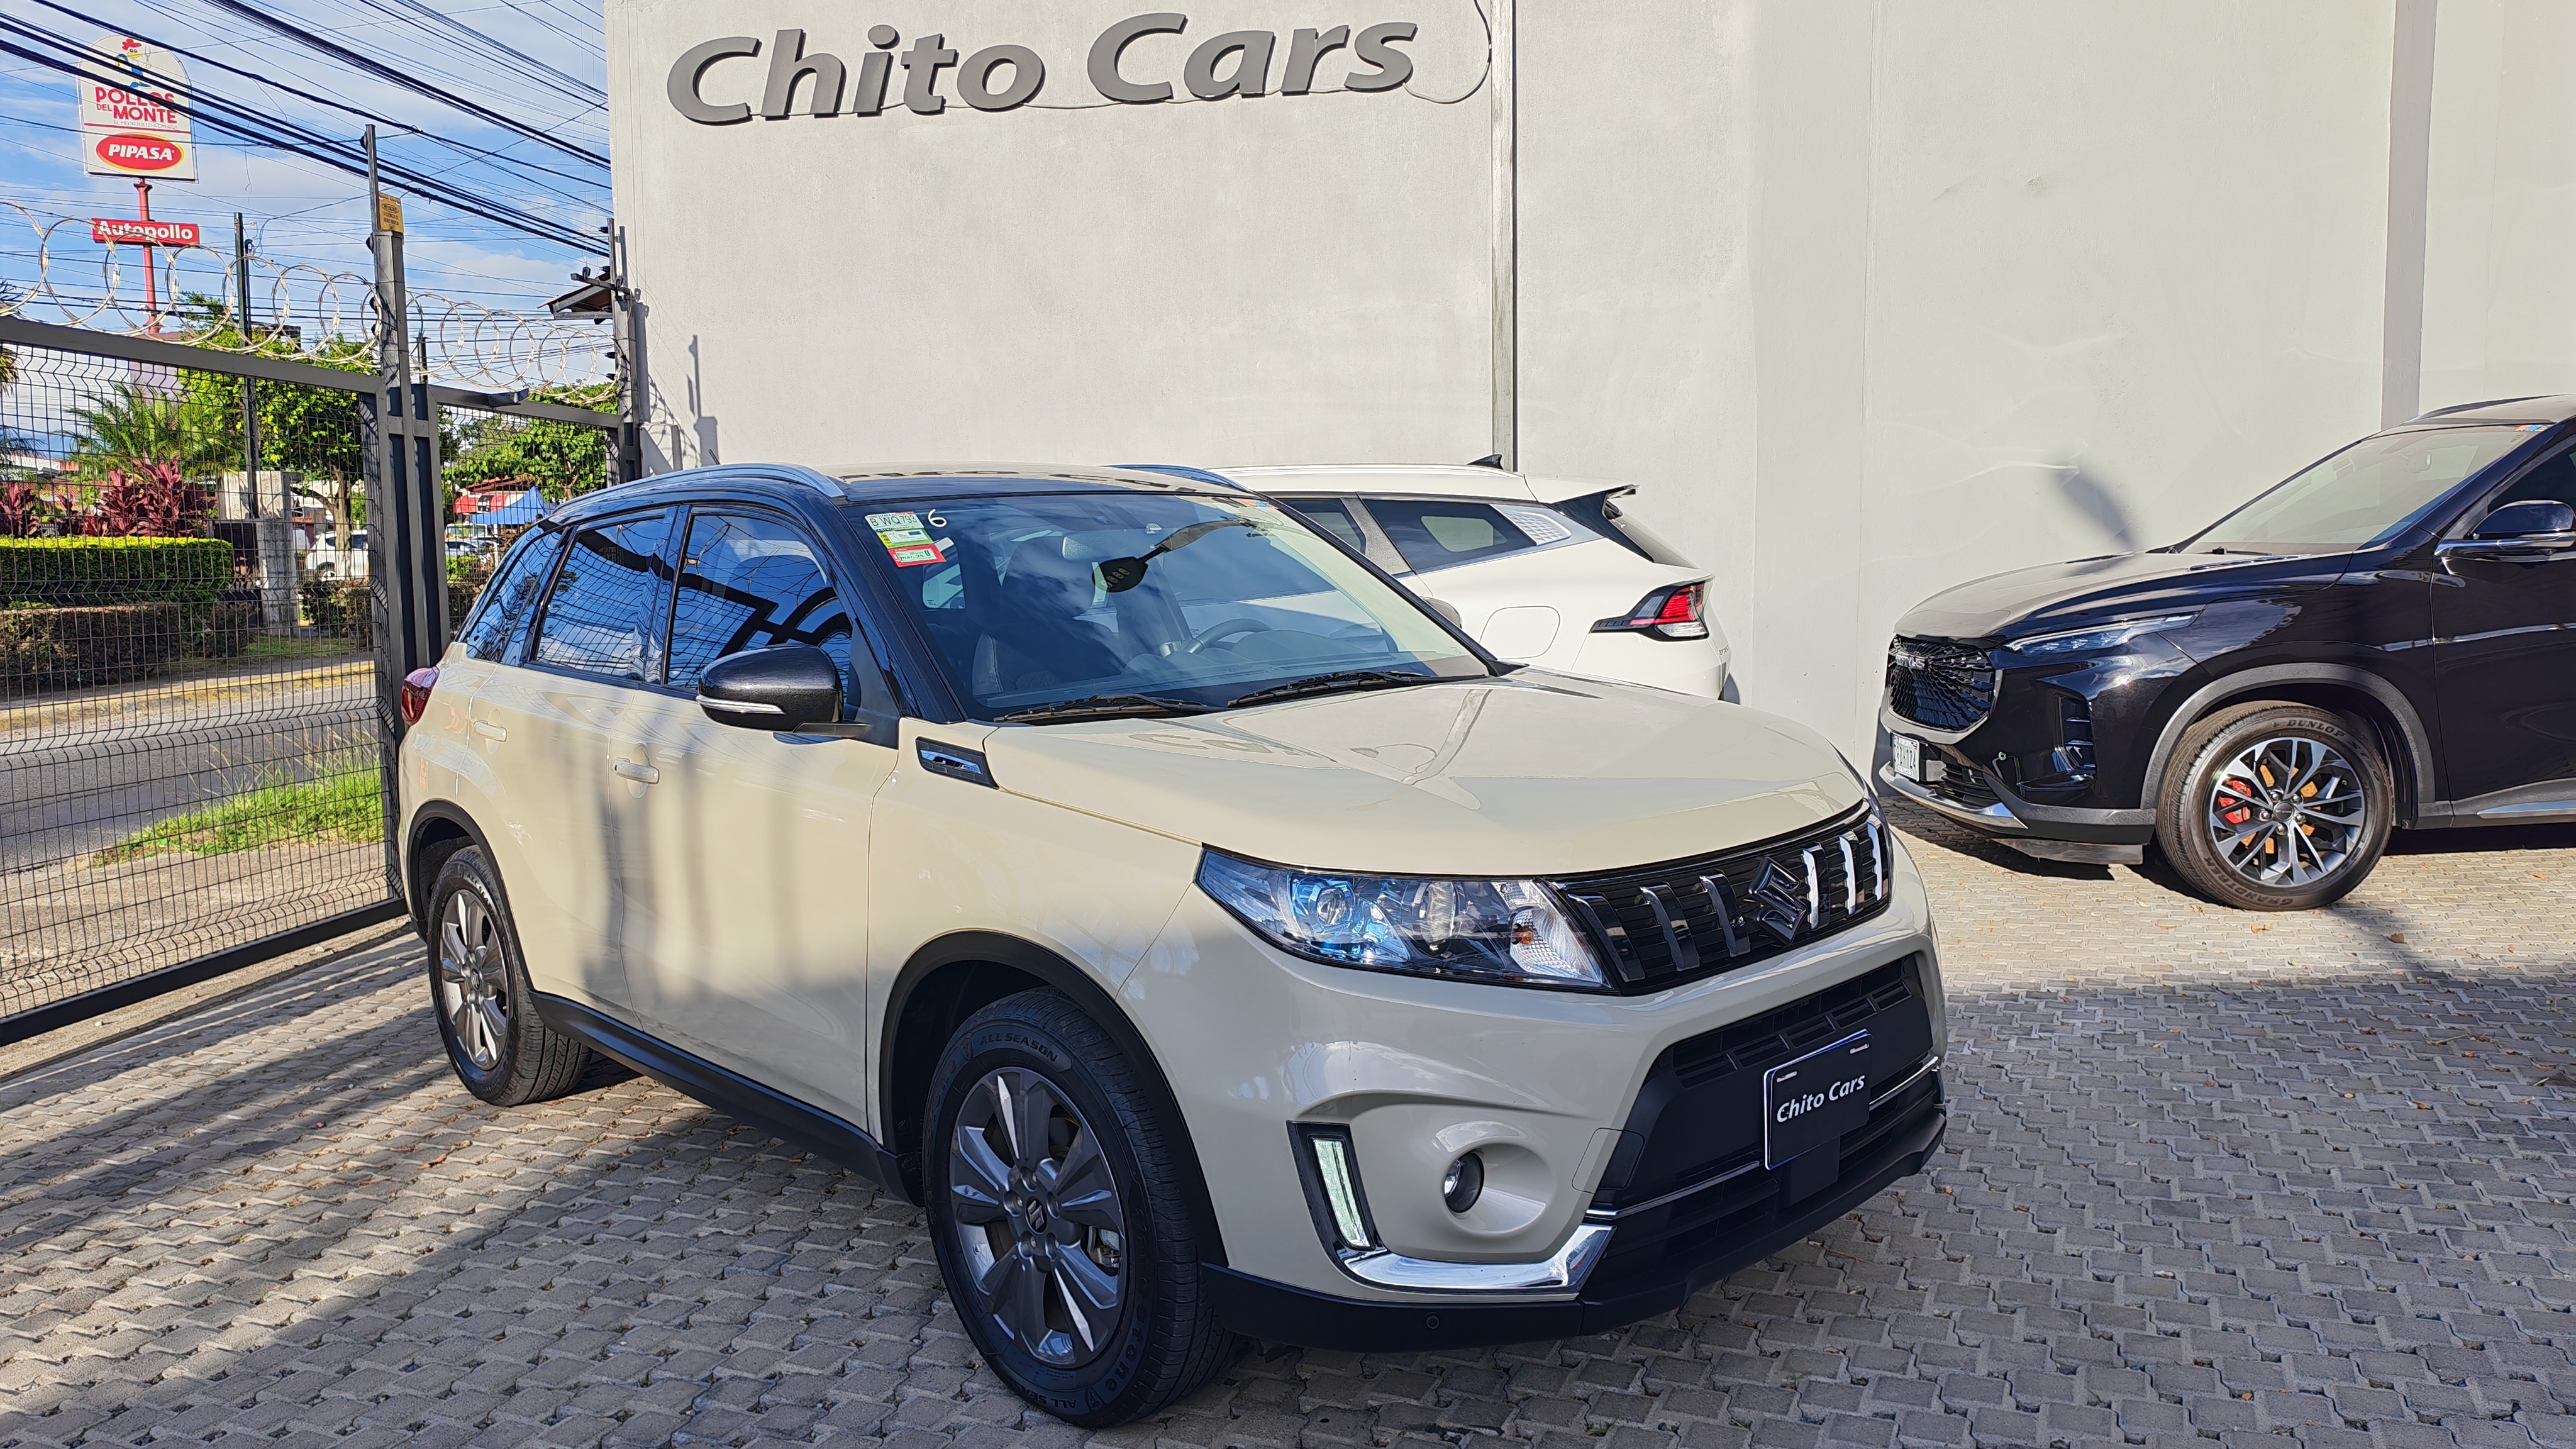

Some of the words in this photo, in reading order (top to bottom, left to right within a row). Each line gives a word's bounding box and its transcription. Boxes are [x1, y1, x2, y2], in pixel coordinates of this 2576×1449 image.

[667, 25, 1045, 125] Chito
[1087, 13, 1418, 104] Cars
[95, 86, 175, 108] POLLOS
[96, 103, 113, 112] DEL
[113, 104, 177, 124] MONTE
[108, 143, 173, 161] PIPASA
[97, 220, 193, 241] Autopollo
[928, 509, 947, 528] 6
[2287, 719, 2345, 738] DUNLOP
[2204, 856, 2294, 906] GRANDTREK
[980, 1033, 1002, 1046] ALL
[1004, 1033, 1058, 1063] SEASON
[1777, 1092, 1824, 1123] Chito
[1828, 1075, 1865, 1101] Cars
[1050, 1397, 1077, 1409] ALL
